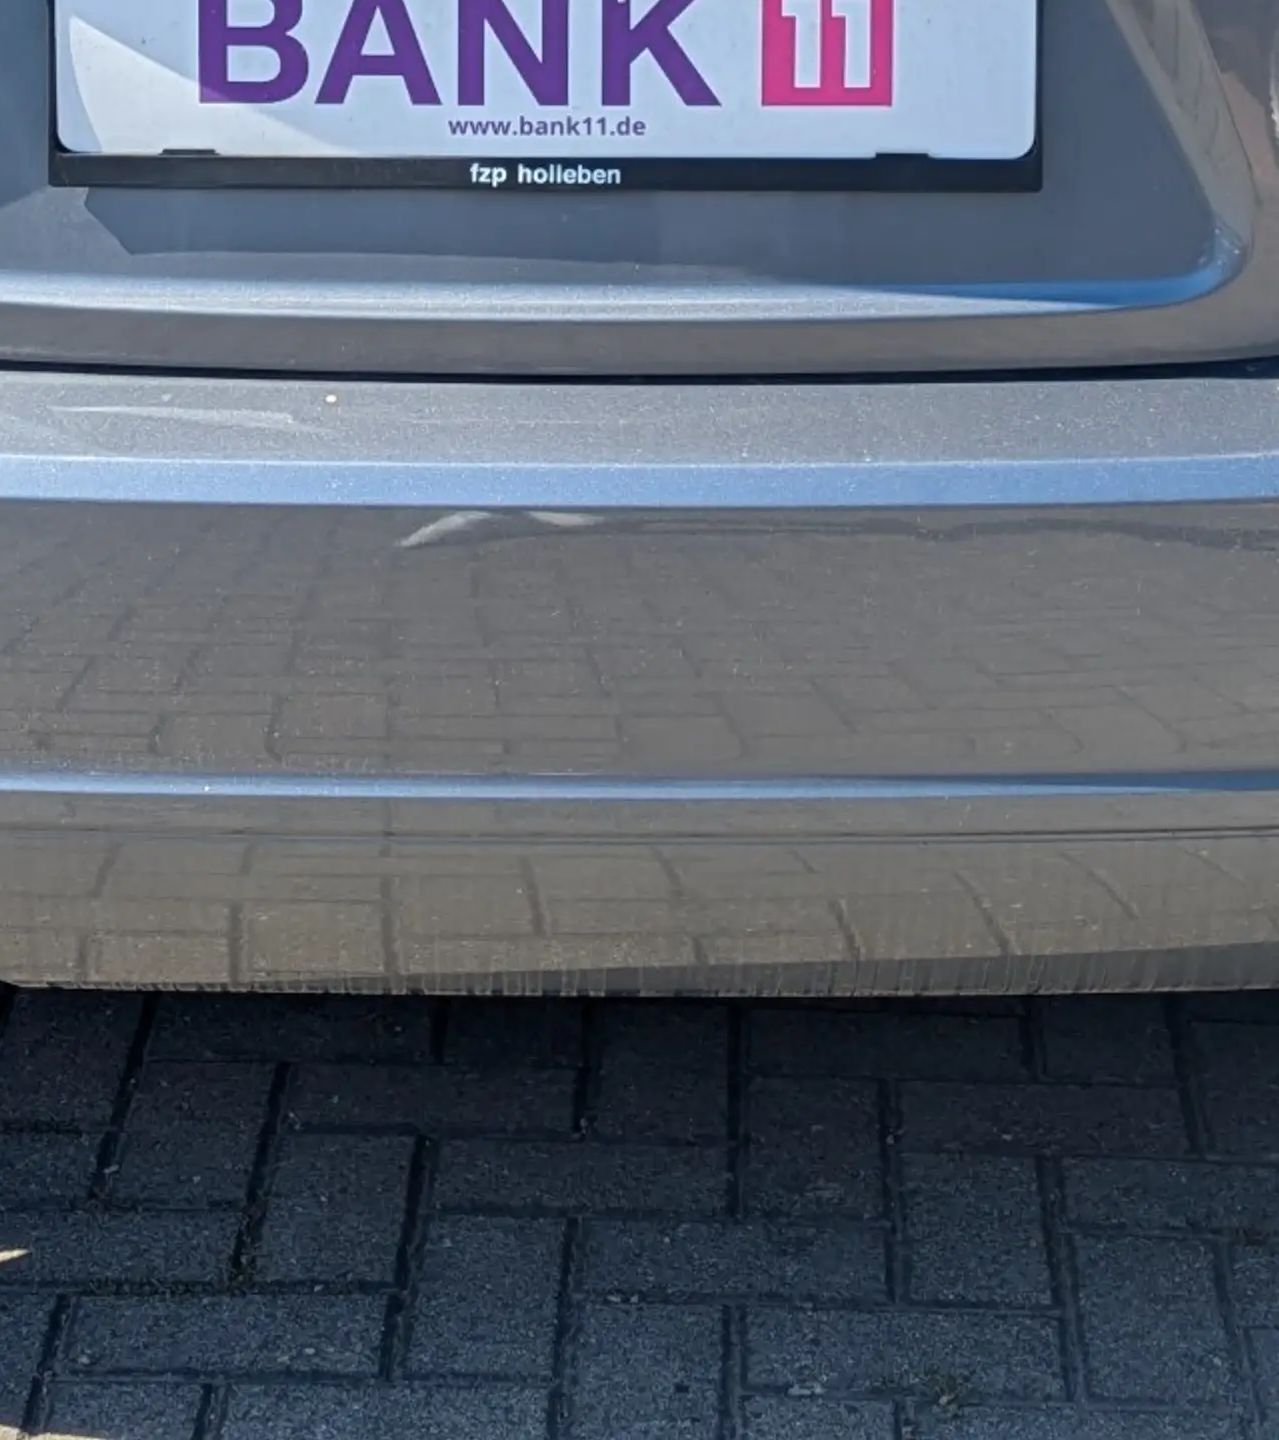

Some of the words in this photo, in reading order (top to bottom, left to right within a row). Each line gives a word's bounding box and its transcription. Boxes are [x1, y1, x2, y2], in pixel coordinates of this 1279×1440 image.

[447, 114, 648, 137] www.bank11.de
[469, 162, 508, 188] fzp
[516, 162, 622, 185] holleben
